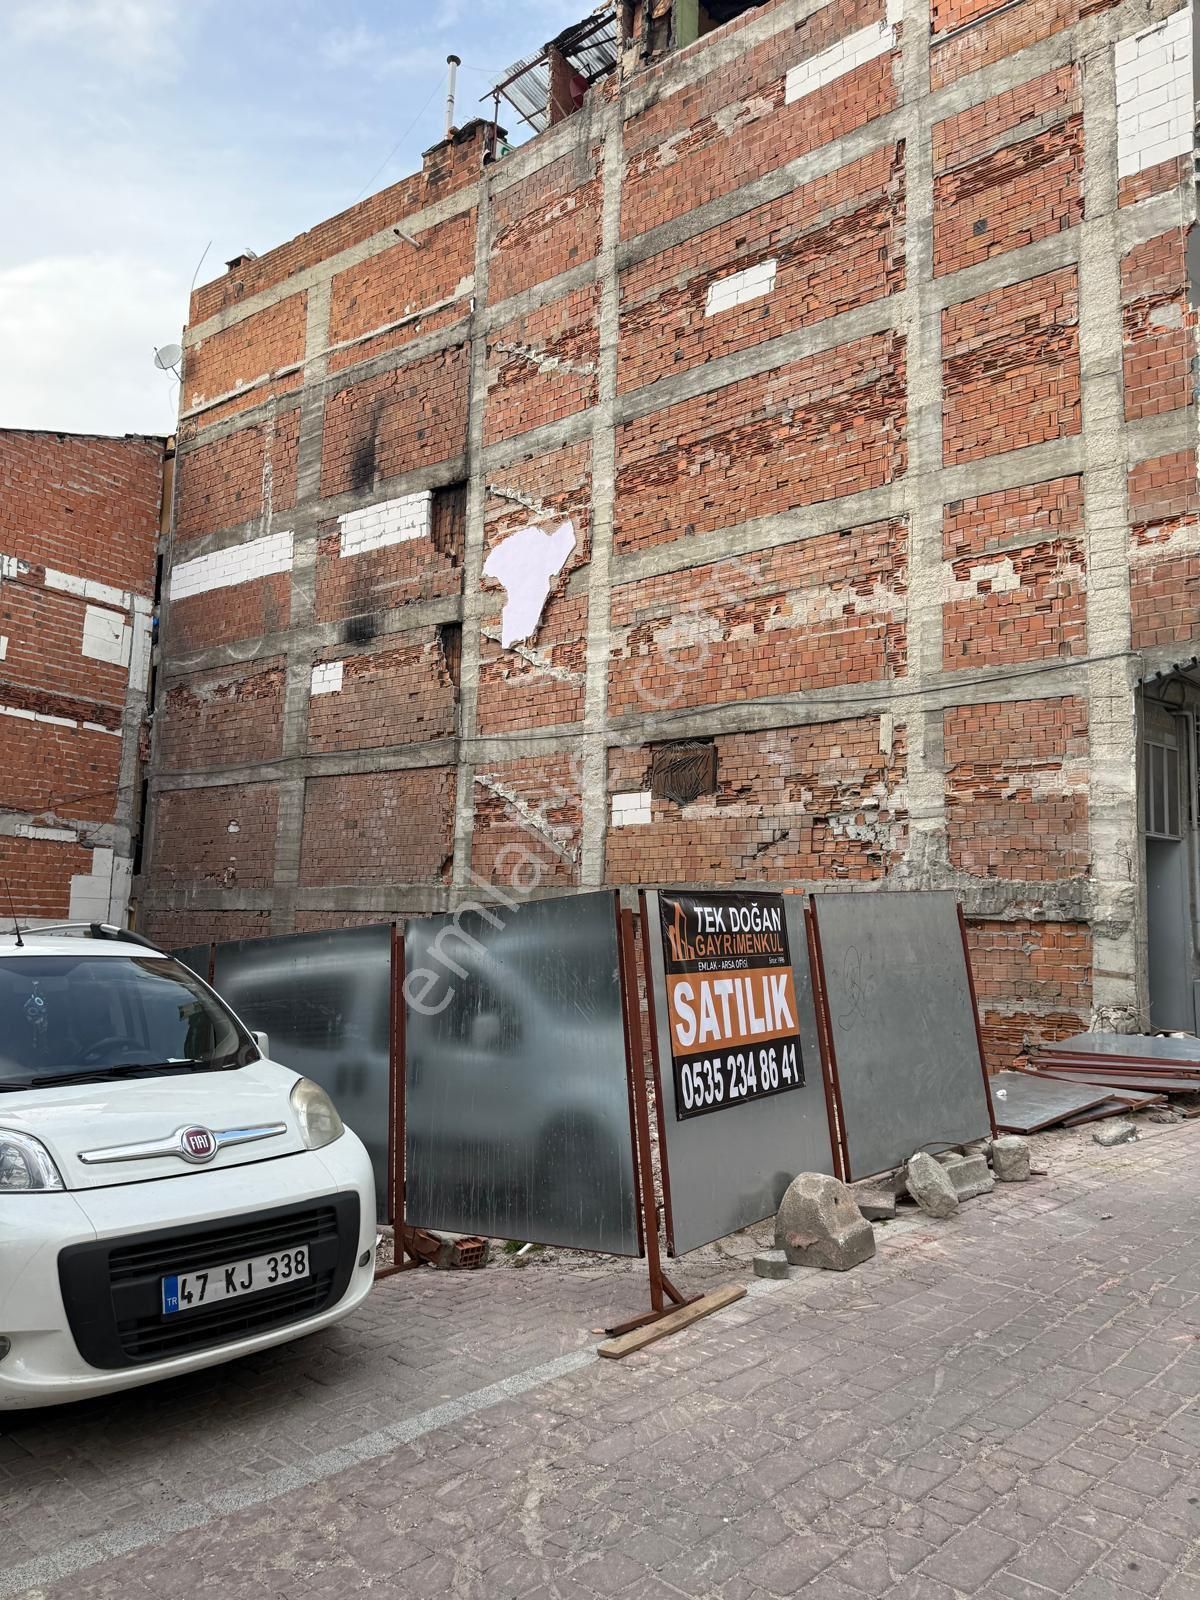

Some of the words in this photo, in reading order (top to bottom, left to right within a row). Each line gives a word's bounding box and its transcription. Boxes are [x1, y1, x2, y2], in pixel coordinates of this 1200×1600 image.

[694, 907, 726, 933] TEK
[729, 902, 781, 932] DOĞAN
[698, 961, 718, 971] EMLAK
[721, 960, 735, 969] ARSA
[673, 974, 795, 1047] SATILIK
[681, 1058, 724, 1109] 0535
[727, 1051, 757, 1098] 234
[759, 1047, 779, 1090] 86
[782, 1043, 799, 1084] 41
[189, 1135, 208, 1150] FIAT
[167, 1296, 178, 1306] TR
[181, 1273, 209, 1304] 47
[225, 1263, 253, 1293] KJ
[267, 1250, 305, 1283] 338
